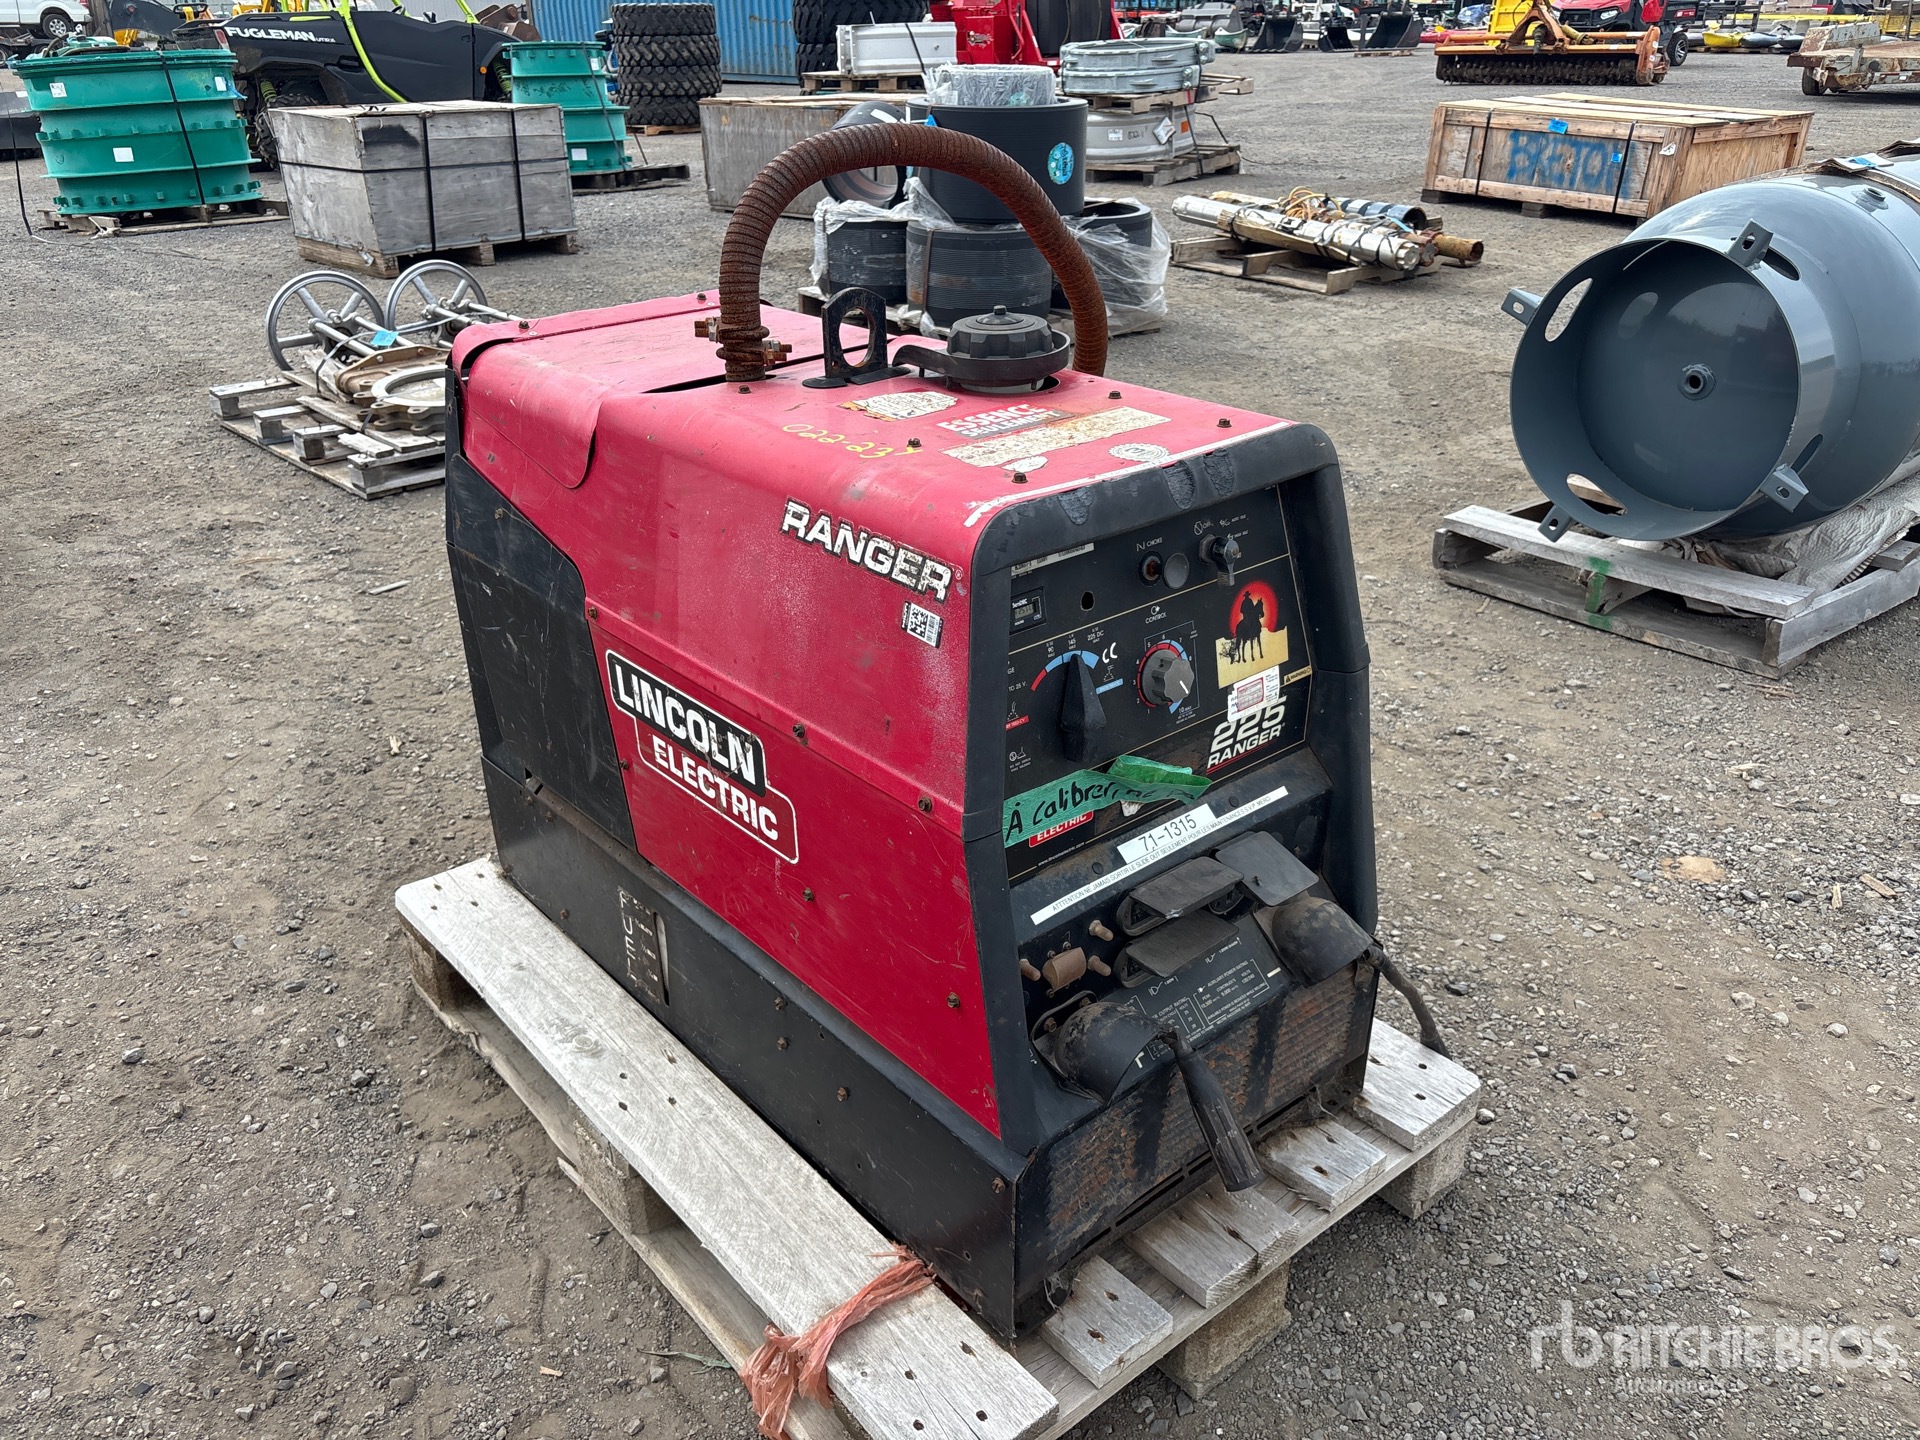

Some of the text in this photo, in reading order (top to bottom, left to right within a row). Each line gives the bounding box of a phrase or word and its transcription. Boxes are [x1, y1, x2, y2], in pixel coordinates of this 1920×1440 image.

[223, 26, 316, 42] FUGLEMAN
[936, 403, 1048, 431] ESSENCE
[961, 409, 1061, 437] SEULEMENT
[781, 500, 953, 601] RANGER
[1145, 612, 1167, 624] CONTROL
[615, 663, 757, 786] LINCOLN
[1207, 724, 1283, 769] RANGER
[1210, 695, 1287, 753] 225
[652, 734, 779, 842] ELECTRIC
[1036, 815, 1087, 842] ELECTRIC
[1083, 886, 1091, 894] NE
[1091, 877, 1110, 890] JAMAIS
[1109, 867, 1129, 881] SORTIR
[1128, 863, 1136, 871] LE
[1135, 856, 1150, 867] SLIDE
[1149, 851, 1160, 860] OUT
[1159, 836, 1188, 855] SEULEMENT
[1187, 829, 1202, 840] POUR
[1201, 825, 1211, 833] LES
[1255, 794, 1270, 806] MERCI
